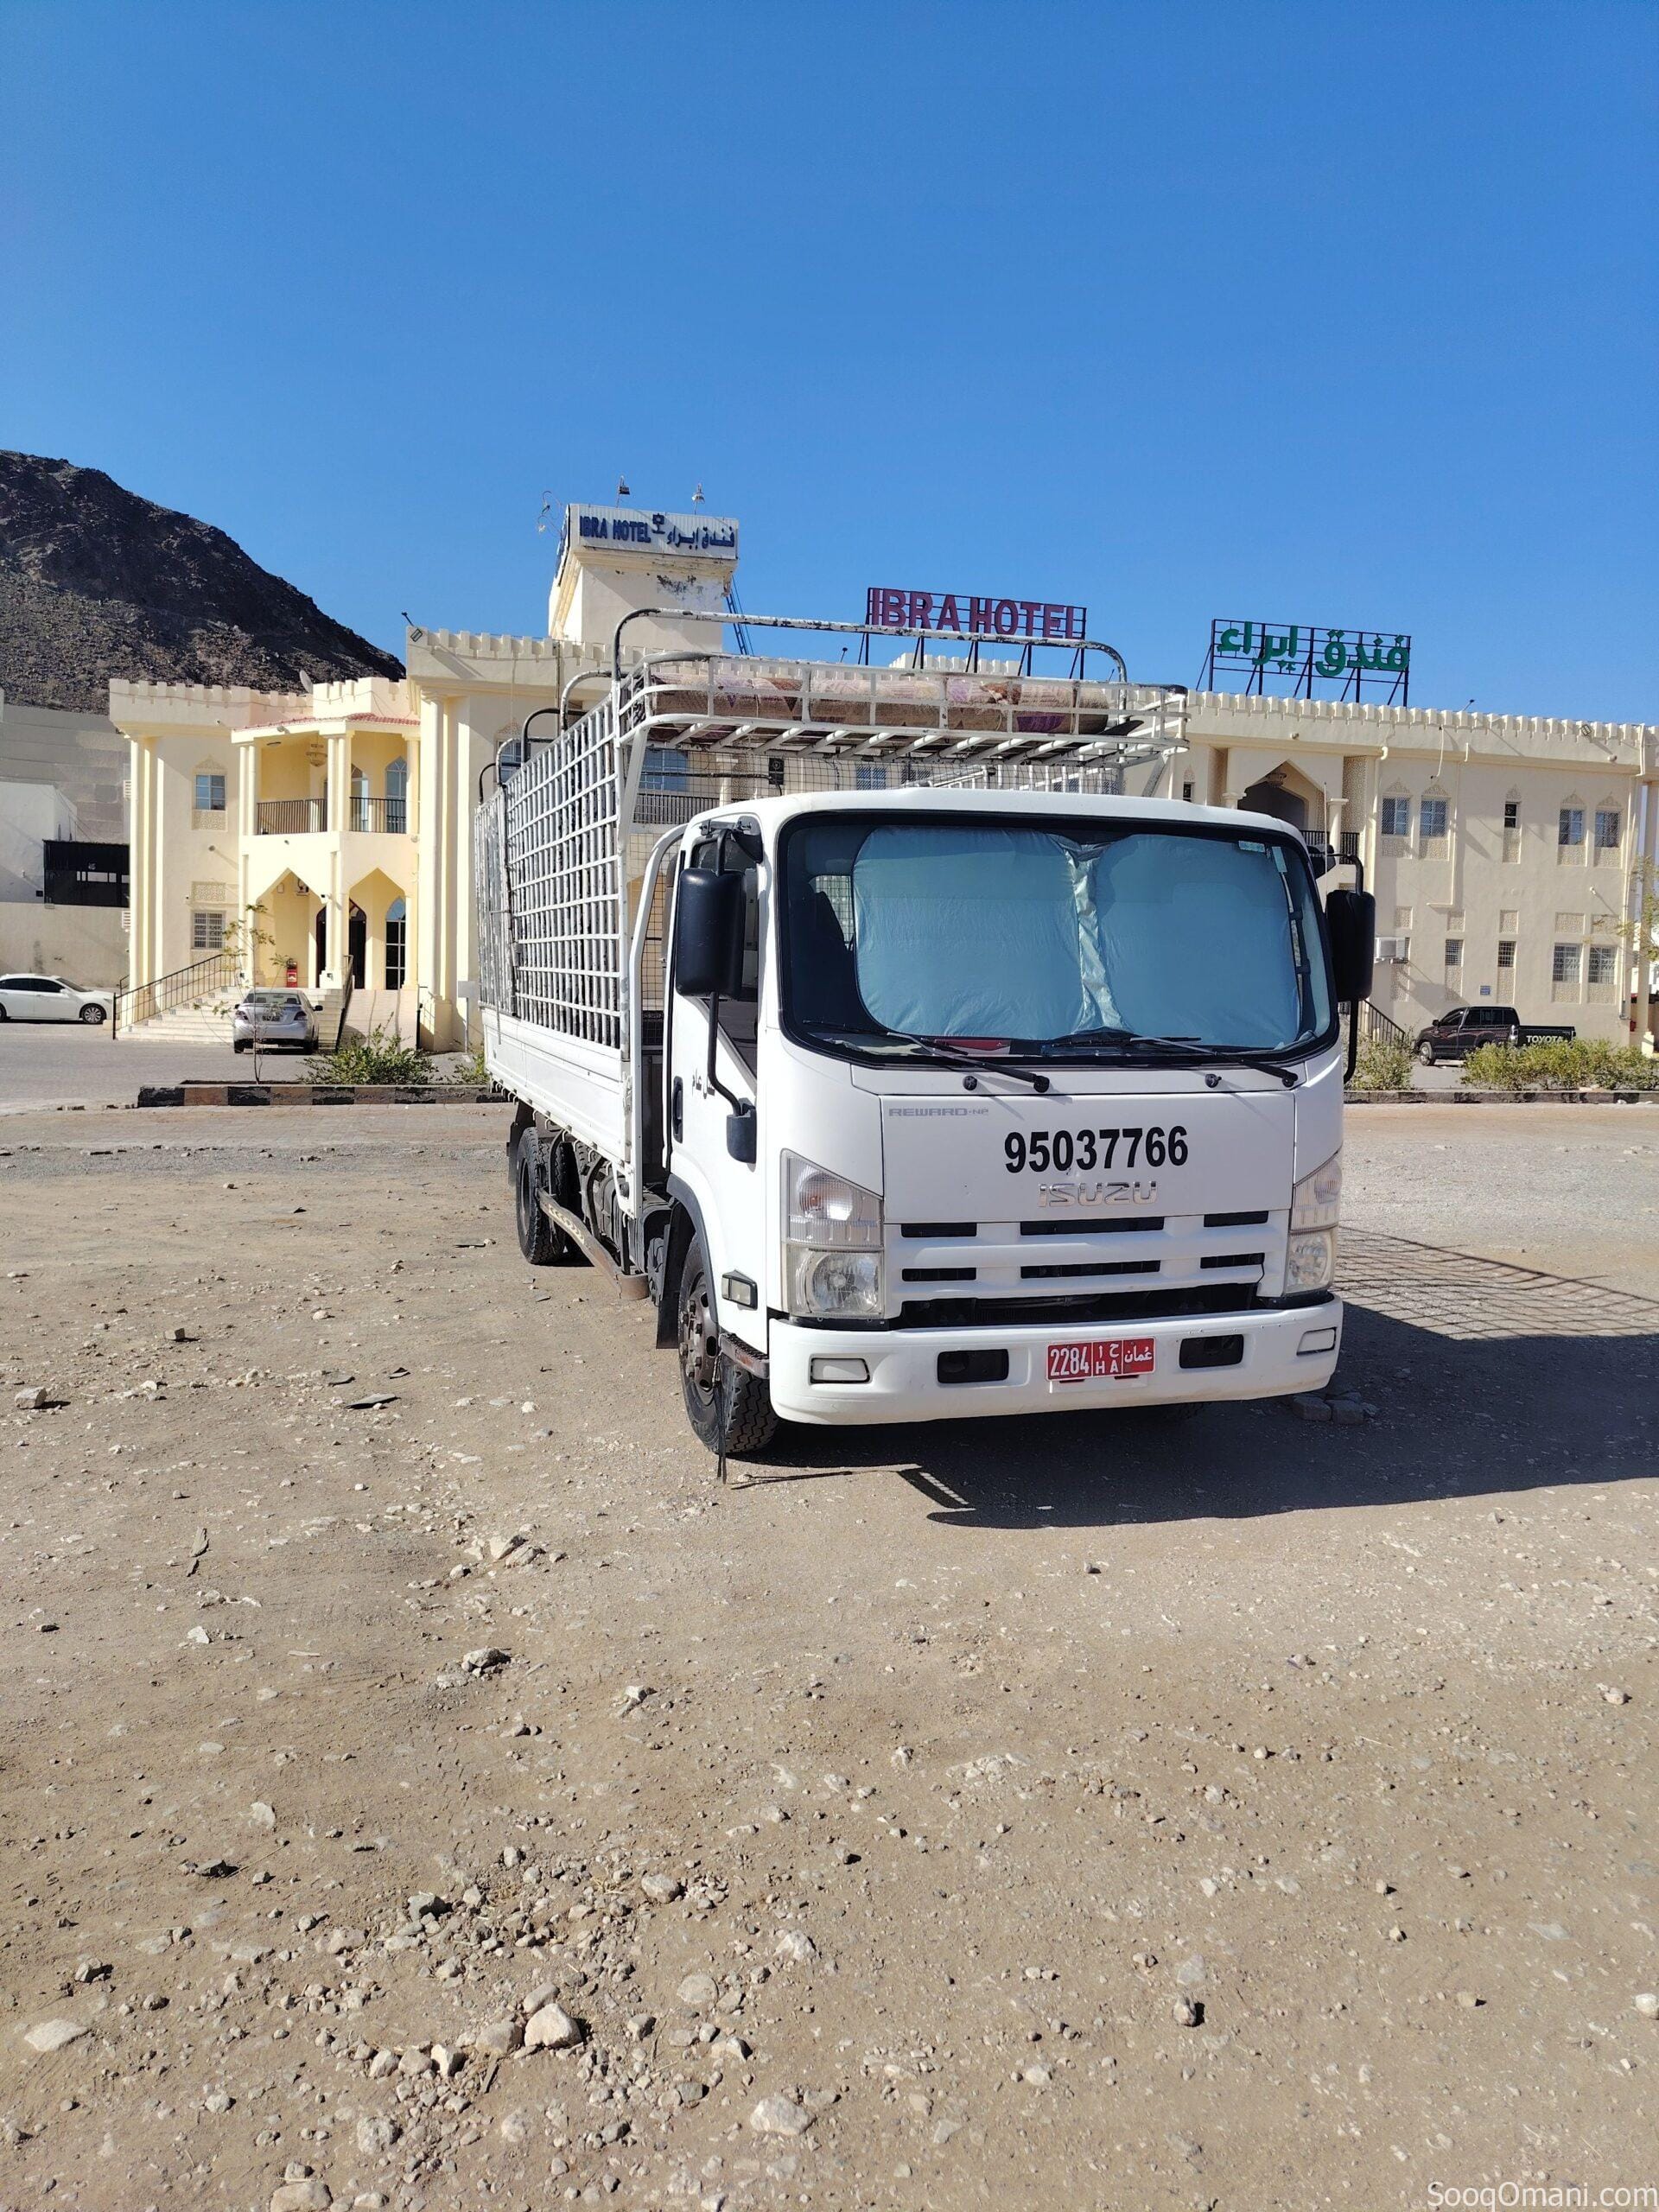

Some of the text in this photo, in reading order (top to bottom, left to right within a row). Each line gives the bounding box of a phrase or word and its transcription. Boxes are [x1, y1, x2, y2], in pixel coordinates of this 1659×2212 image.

[579, 516, 652, 543] IBRA HOTEL
[702, 525, 735, 550] فندق
[871, 588, 1083, 640] IBRA HOTEL
[1315, 629, 1409, 677] فندق
[1526, 1035, 1563, 1044] TOYOTA
[1004, 1126, 1188, 1173] 95037766
[1038, 1180, 1159, 1208] ISUZU
[1050, 1346, 1090, 1376] 2284
